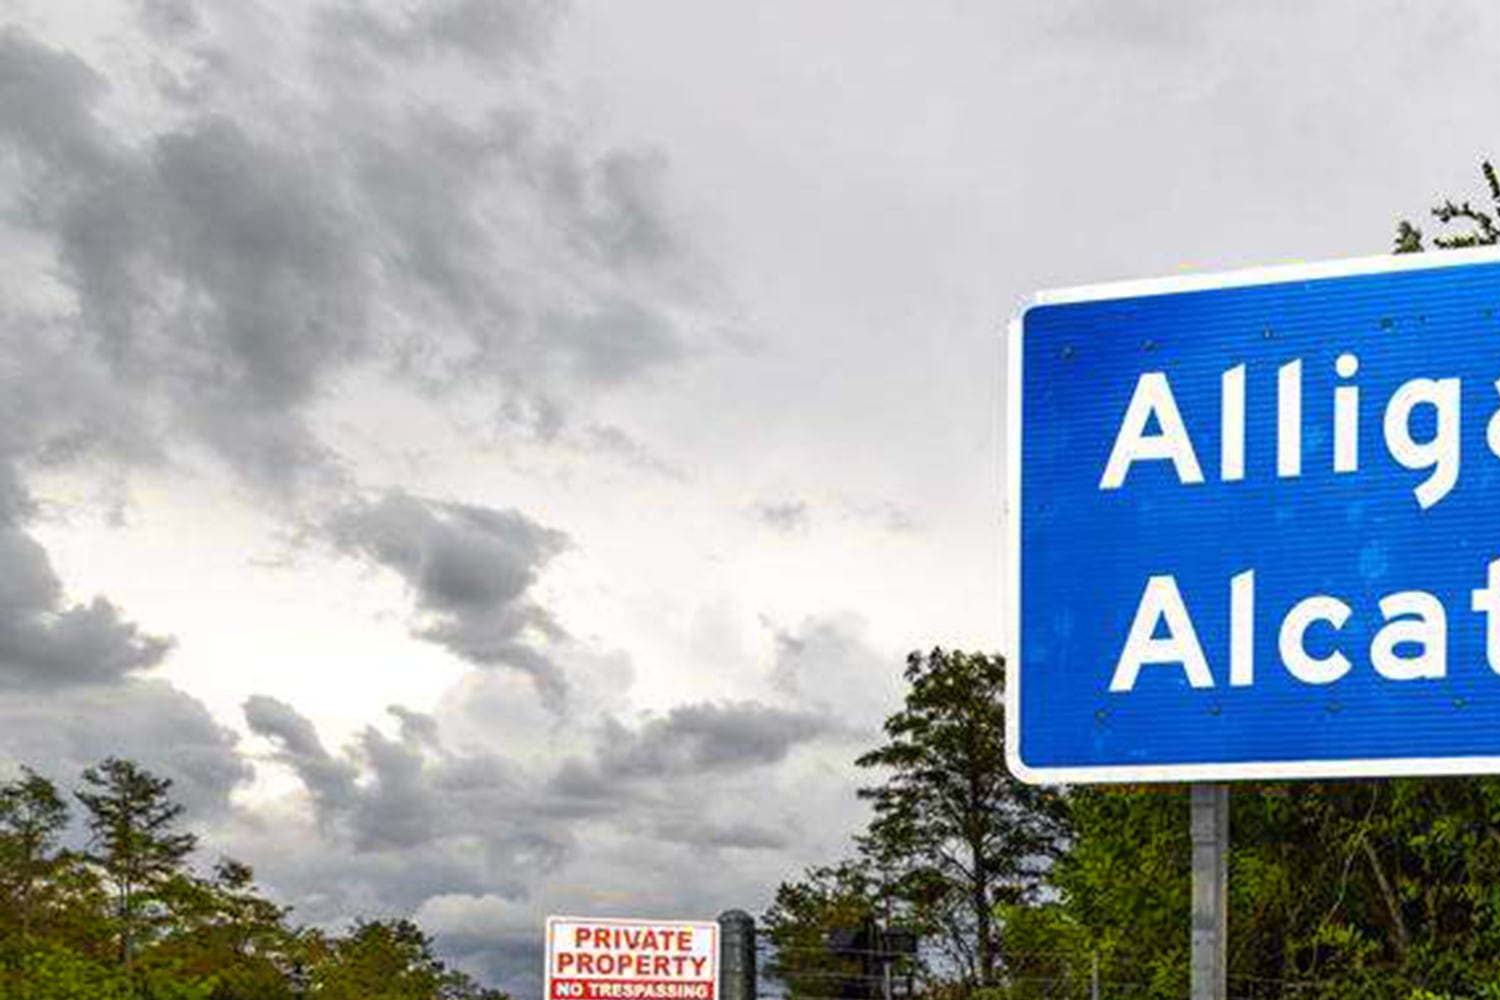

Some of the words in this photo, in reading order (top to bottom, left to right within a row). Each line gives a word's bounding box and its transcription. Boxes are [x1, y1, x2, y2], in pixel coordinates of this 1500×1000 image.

[575, 928, 692, 951] PRIVATE
[557, 953, 707, 976] PROPERTY
[555, 982, 583, 996] NO
[589, 983, 708, 998] TRESPASSING
